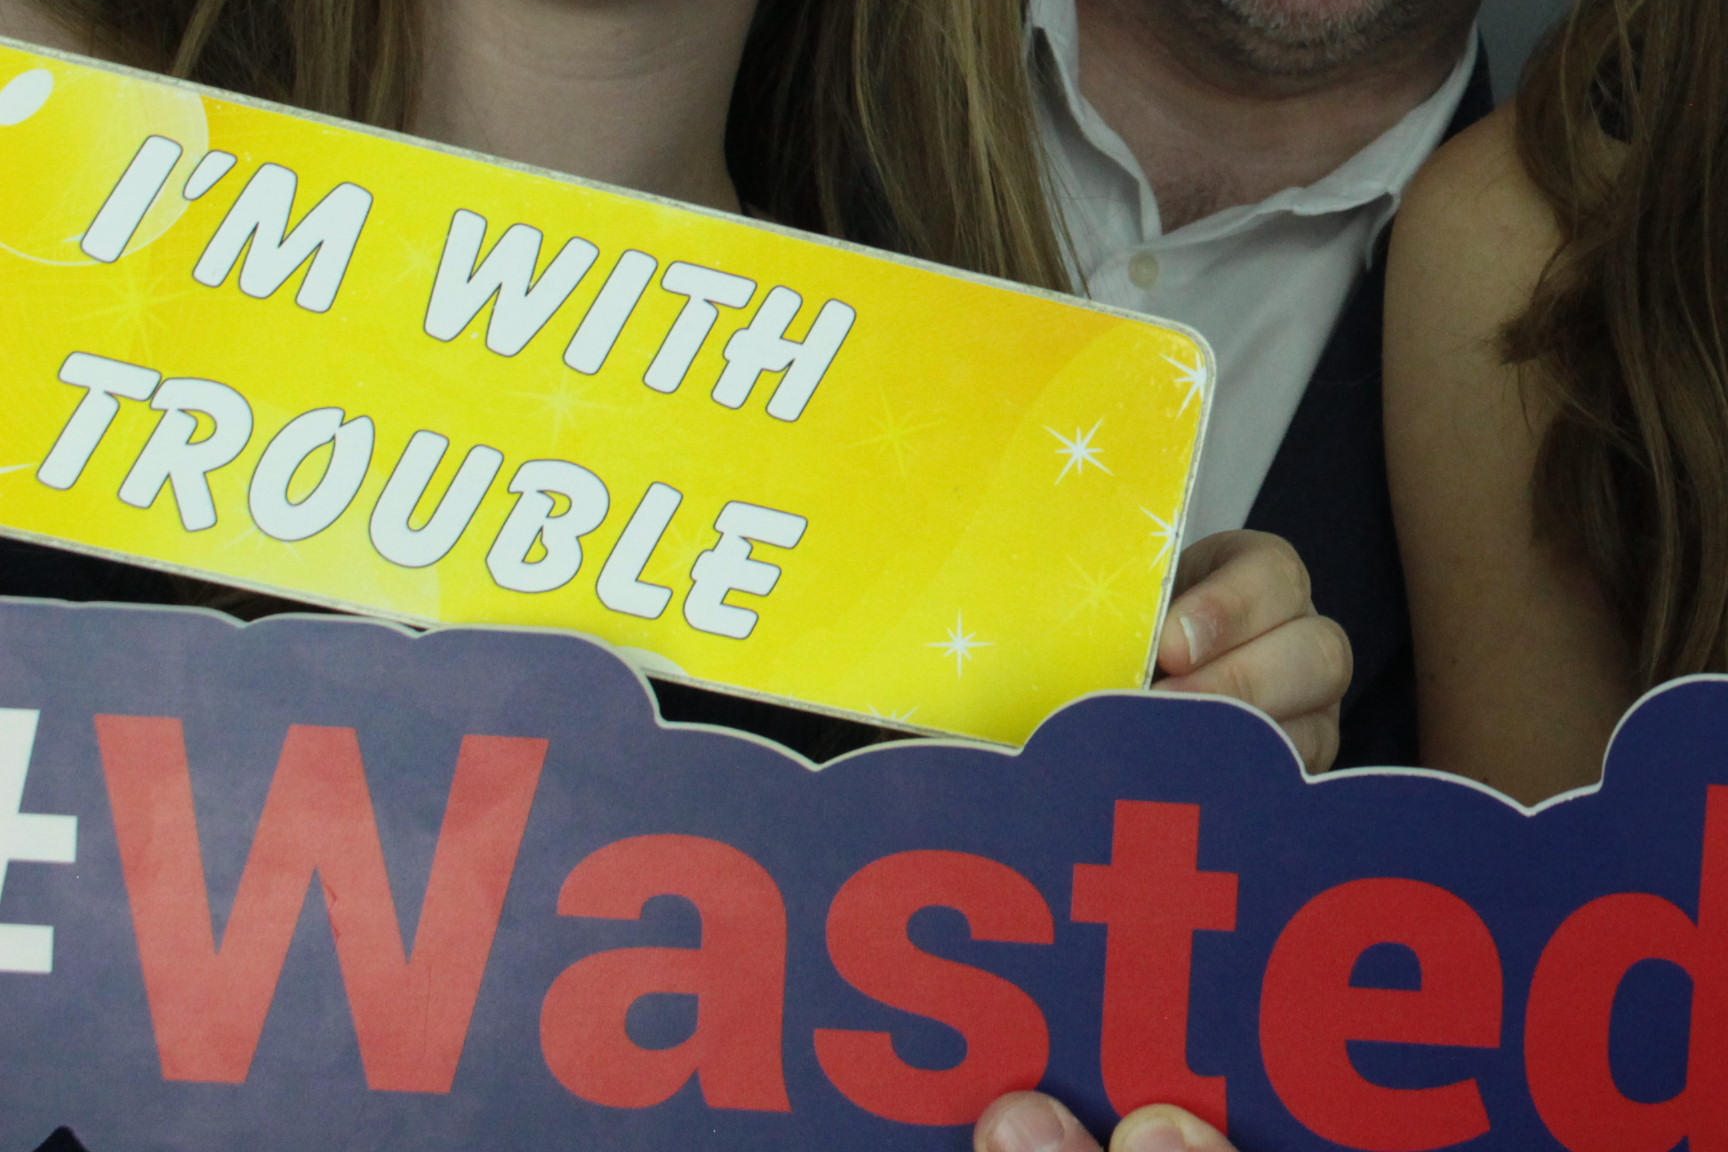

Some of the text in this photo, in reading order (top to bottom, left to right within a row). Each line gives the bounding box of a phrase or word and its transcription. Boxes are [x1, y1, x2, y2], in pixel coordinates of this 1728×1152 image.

[80, 134, 858, 423] I'M WITH
[36, 351, 809, 640] TROUBLE
